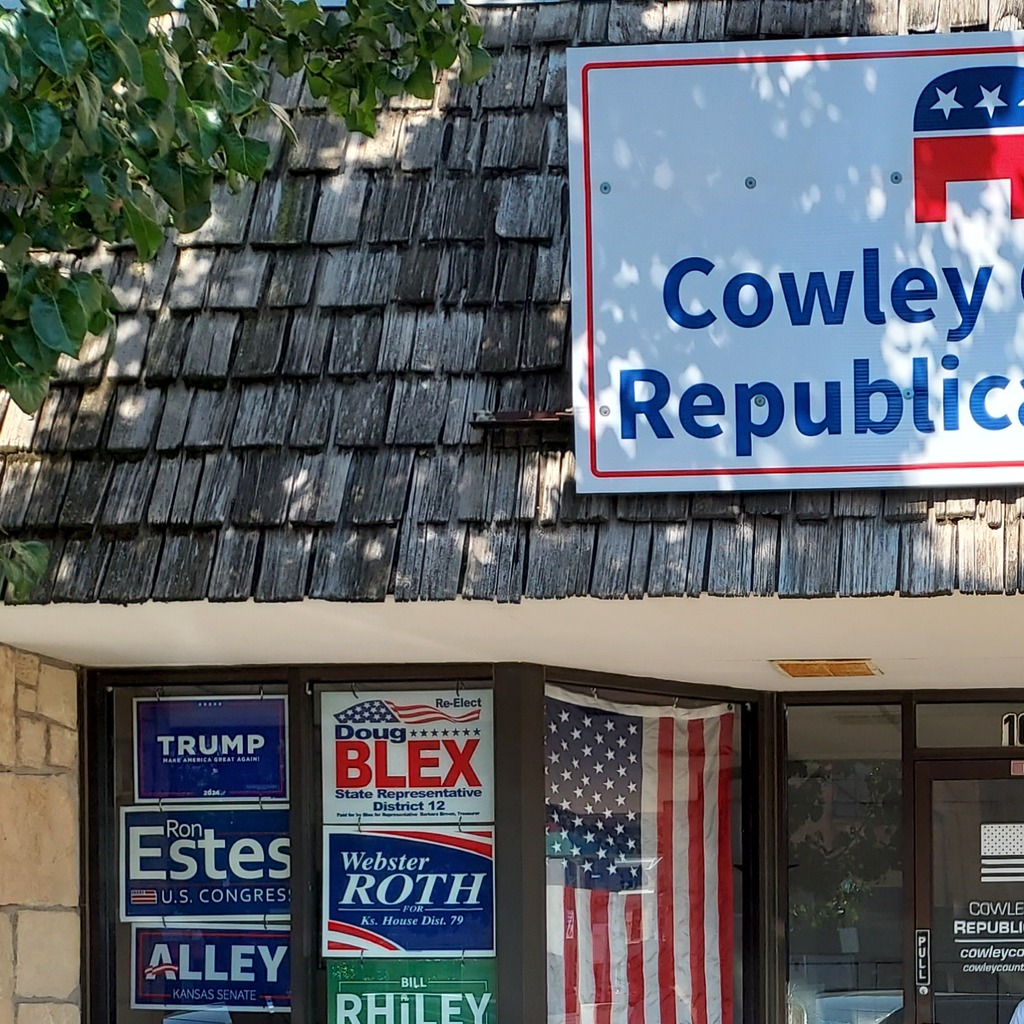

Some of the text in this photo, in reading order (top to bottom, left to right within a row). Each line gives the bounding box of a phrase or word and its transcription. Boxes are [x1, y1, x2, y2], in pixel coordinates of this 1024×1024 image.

[662, 247, 994, 342] Cowley
[435, 698, 482, 708] Re-Elect
[335, 724, 407, 744] Doug
[157, 734, 265, 756] TRUMP
[335, 739, 482, 789] BLEX
[335, 788, 482, 800] State Representative
[373, 801, 445, 812] District 12
[166, 819, 203, 838] Ron
[129, 826, 291, 881] Estes
[341, 851, 430, 871] Webster
[161, 888, 291, 904] U.S. CONGRES
[338, 873, 487, 905] ROTH
[402, 905, 424, 913] FOR
[360, 915, 464, 926] Ks. House Dist. 79
[145, 943, 288, 982] ALLEY
[918, 936, 927, 979] PULL
[401, 977, 427, 989] BILL
[172, 989, 257, 1001] KANSAS SENATE
